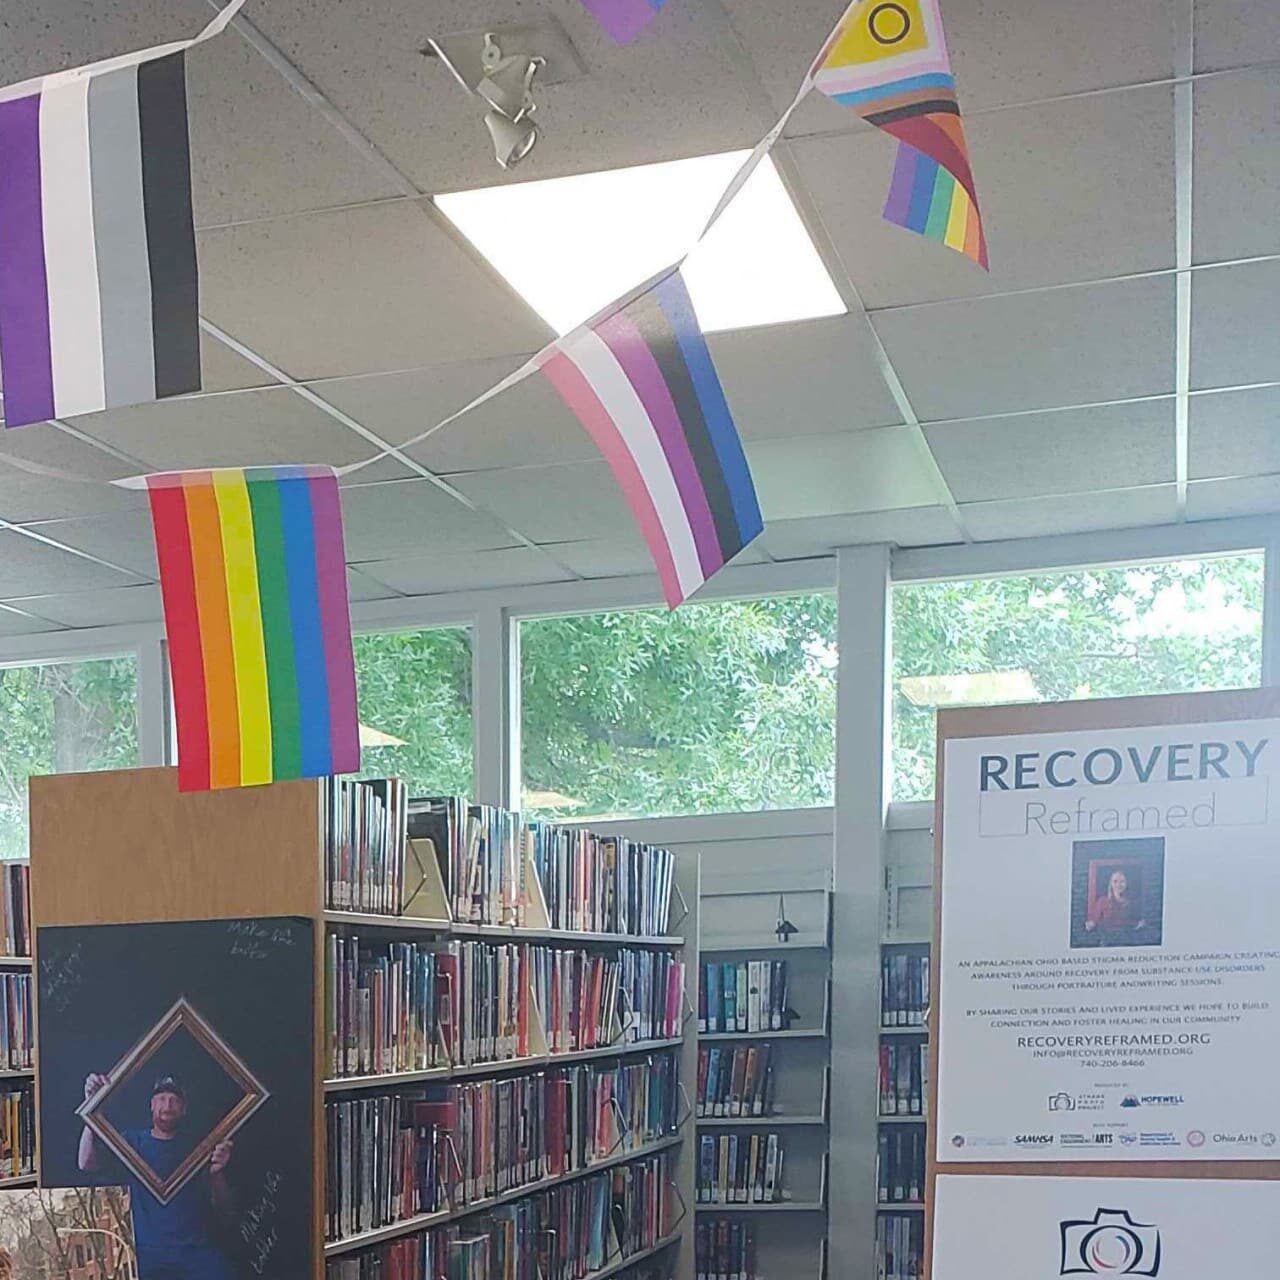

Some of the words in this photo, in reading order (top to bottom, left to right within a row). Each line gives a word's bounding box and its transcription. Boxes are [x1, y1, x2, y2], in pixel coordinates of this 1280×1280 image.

[980, 739, 1269, 792] RECOVERY
[1024, 792, 1215, 836] Reframed
[1017, 1033, 1211, 1048] RECOVERYREFRAMED.ORG
[1140, 1095, 1184, 1104] HOPEWELL
[1014, 1134, 1054, 1144] SAMHSA
[1213, 1134, 1235, 1144] Ohio
[1237, 1134, 1258, 1143] Arts
